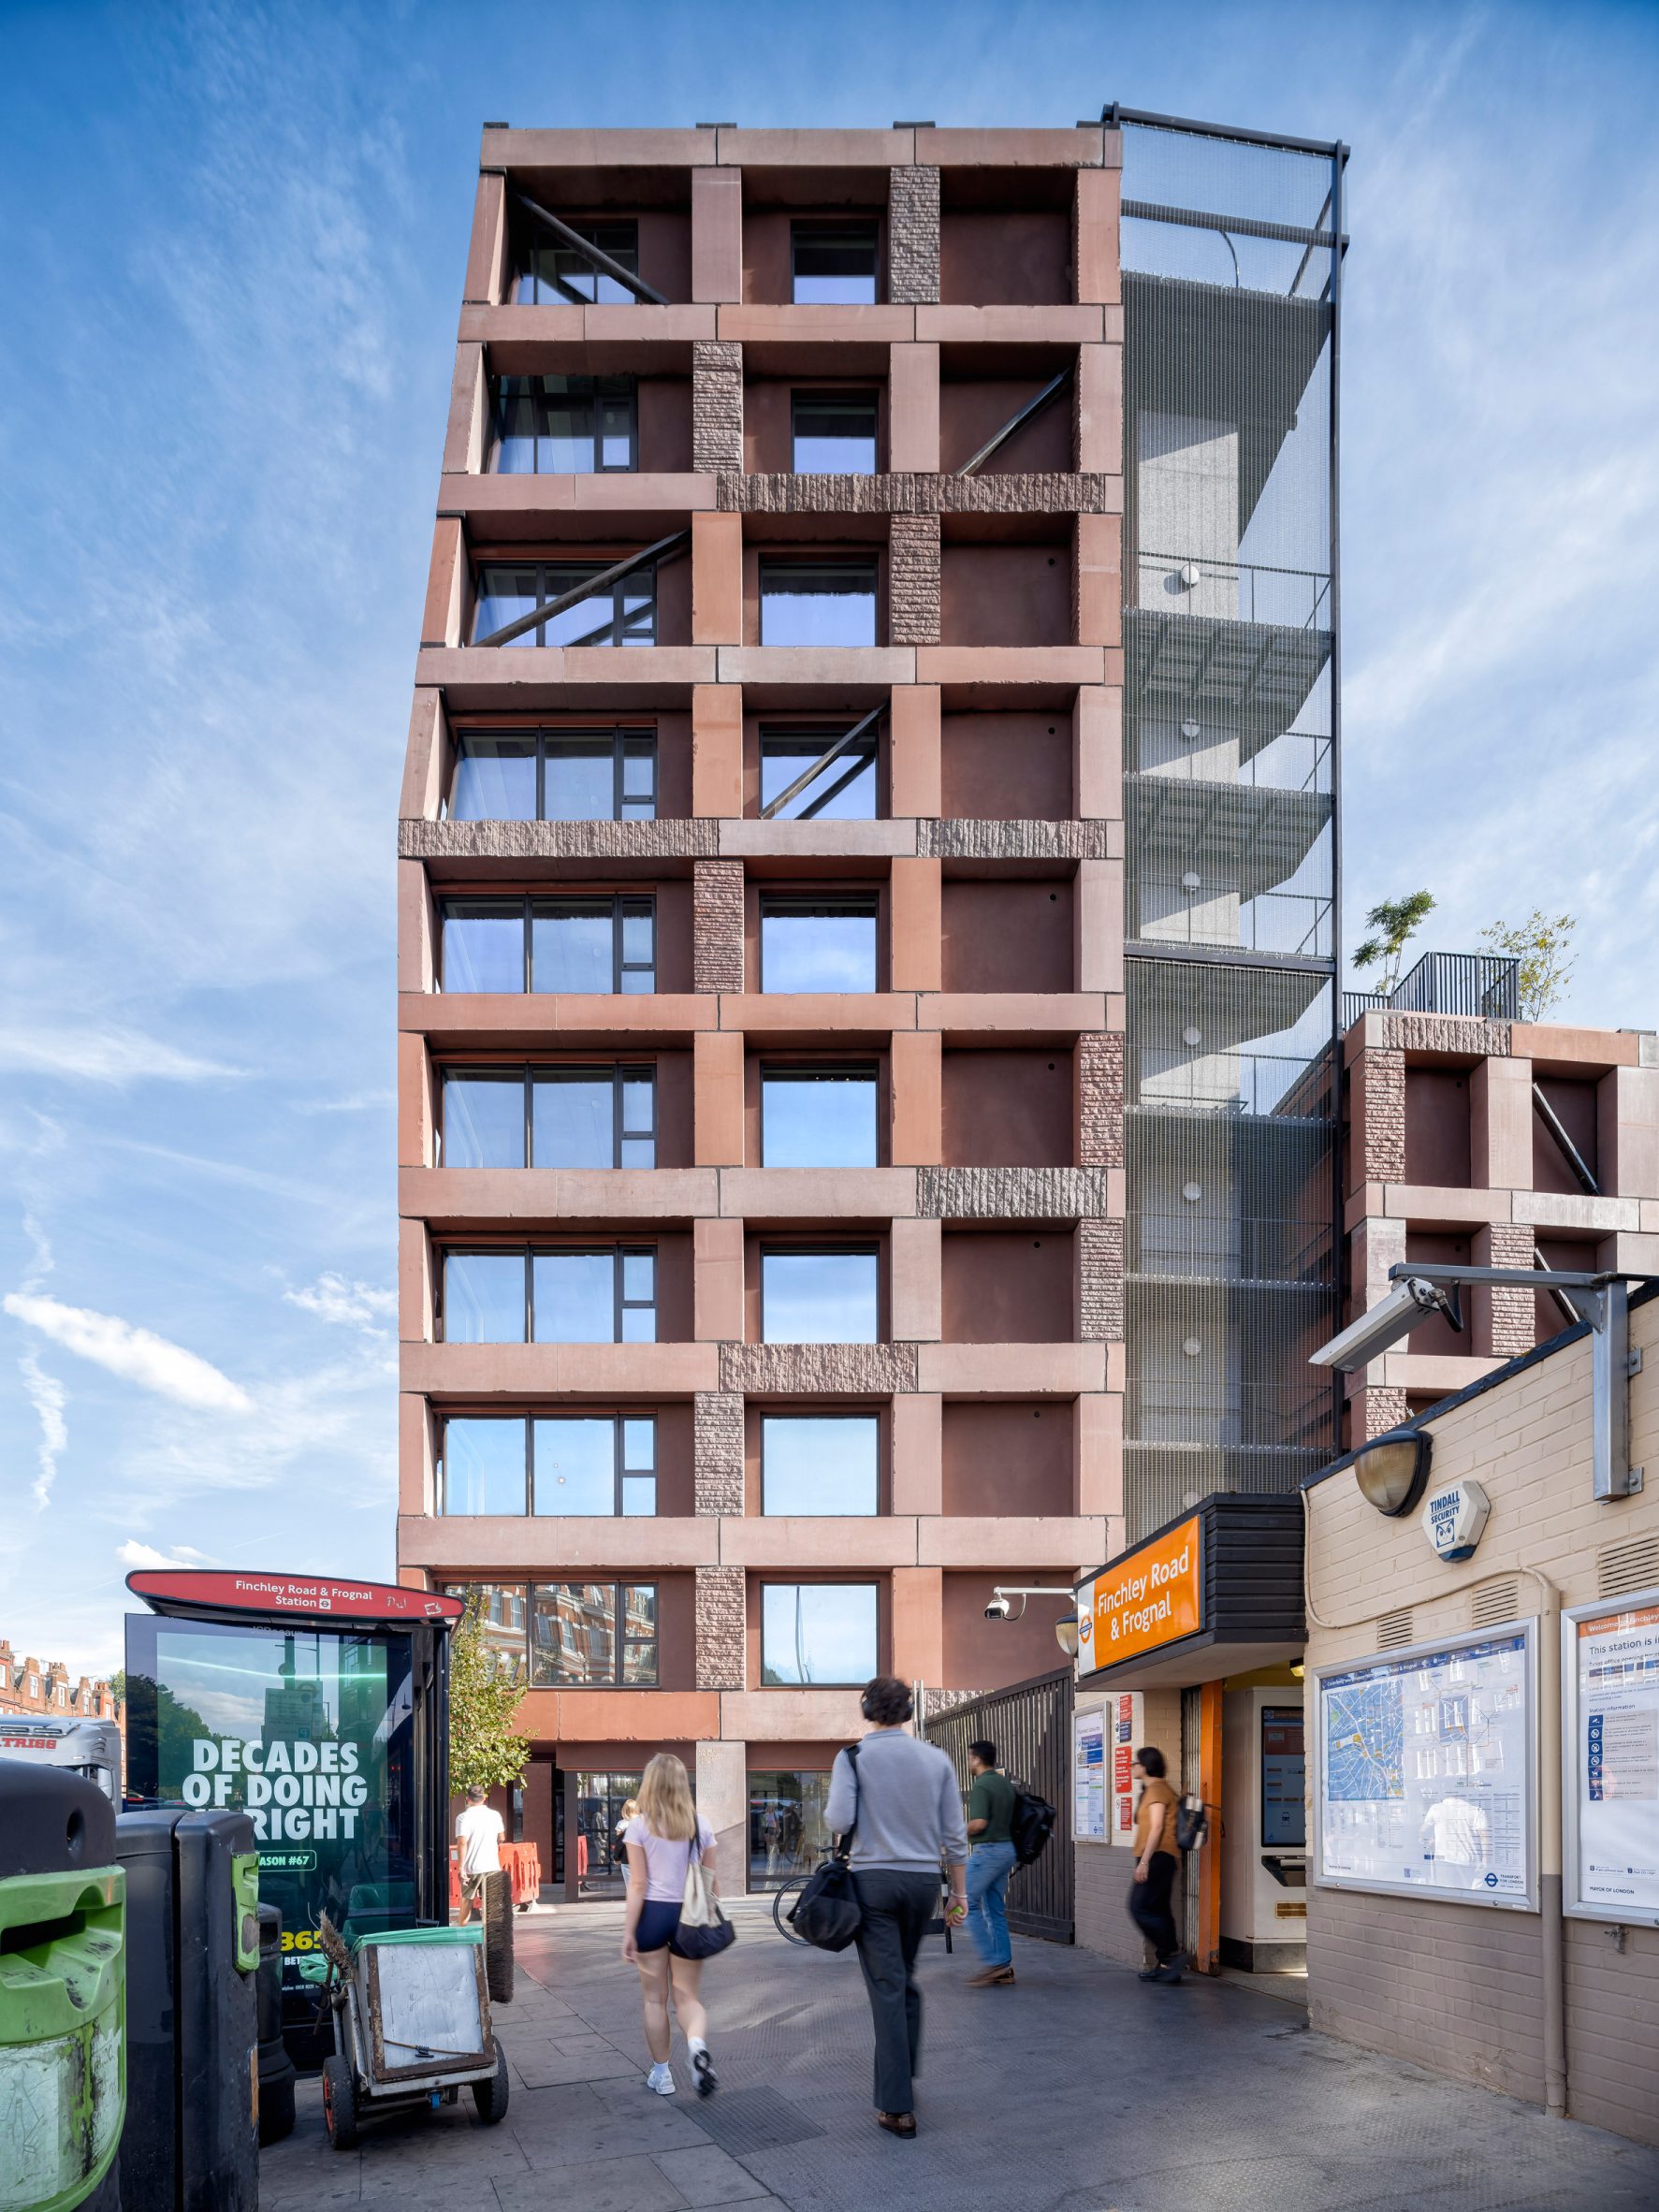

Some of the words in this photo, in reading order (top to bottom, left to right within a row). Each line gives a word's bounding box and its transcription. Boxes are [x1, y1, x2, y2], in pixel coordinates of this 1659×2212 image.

[1430, 1491, 1460, 1513] TINDALL
[1431, 1506, 1460, 1524] SECURITY
[235, 1580, 284, 1594] Finchley
[288, 1584, 317, 1596] Road
[320, 1587, 329, 1596] &
[331, 1588, 372, 1601] Frognal
[1098, 1575, 1147, 1617] Finchley
[1151, 1546, 1188, 1589] Road
[275, 1594, 317, 1608] Station
[1111, 1617, 1120, 1641] &
[1123, 1592, 1171, 1636] Frognal
[1588, 1622, 1618, 1632] Welcome
[1589, 1646, 1607, 1655] This
[1608, 1638, 1641, 1652] station
[1644, 1637, 1652, 1646] is
[193, 1739, 359, 1774] DECADES
[182, 1773, 233, 1807] OF
[247, 1774, 368, 1807] DOING
[242, 1808, 359, 1841] RIGHT
[288, 1855, 310, 1866] #67
